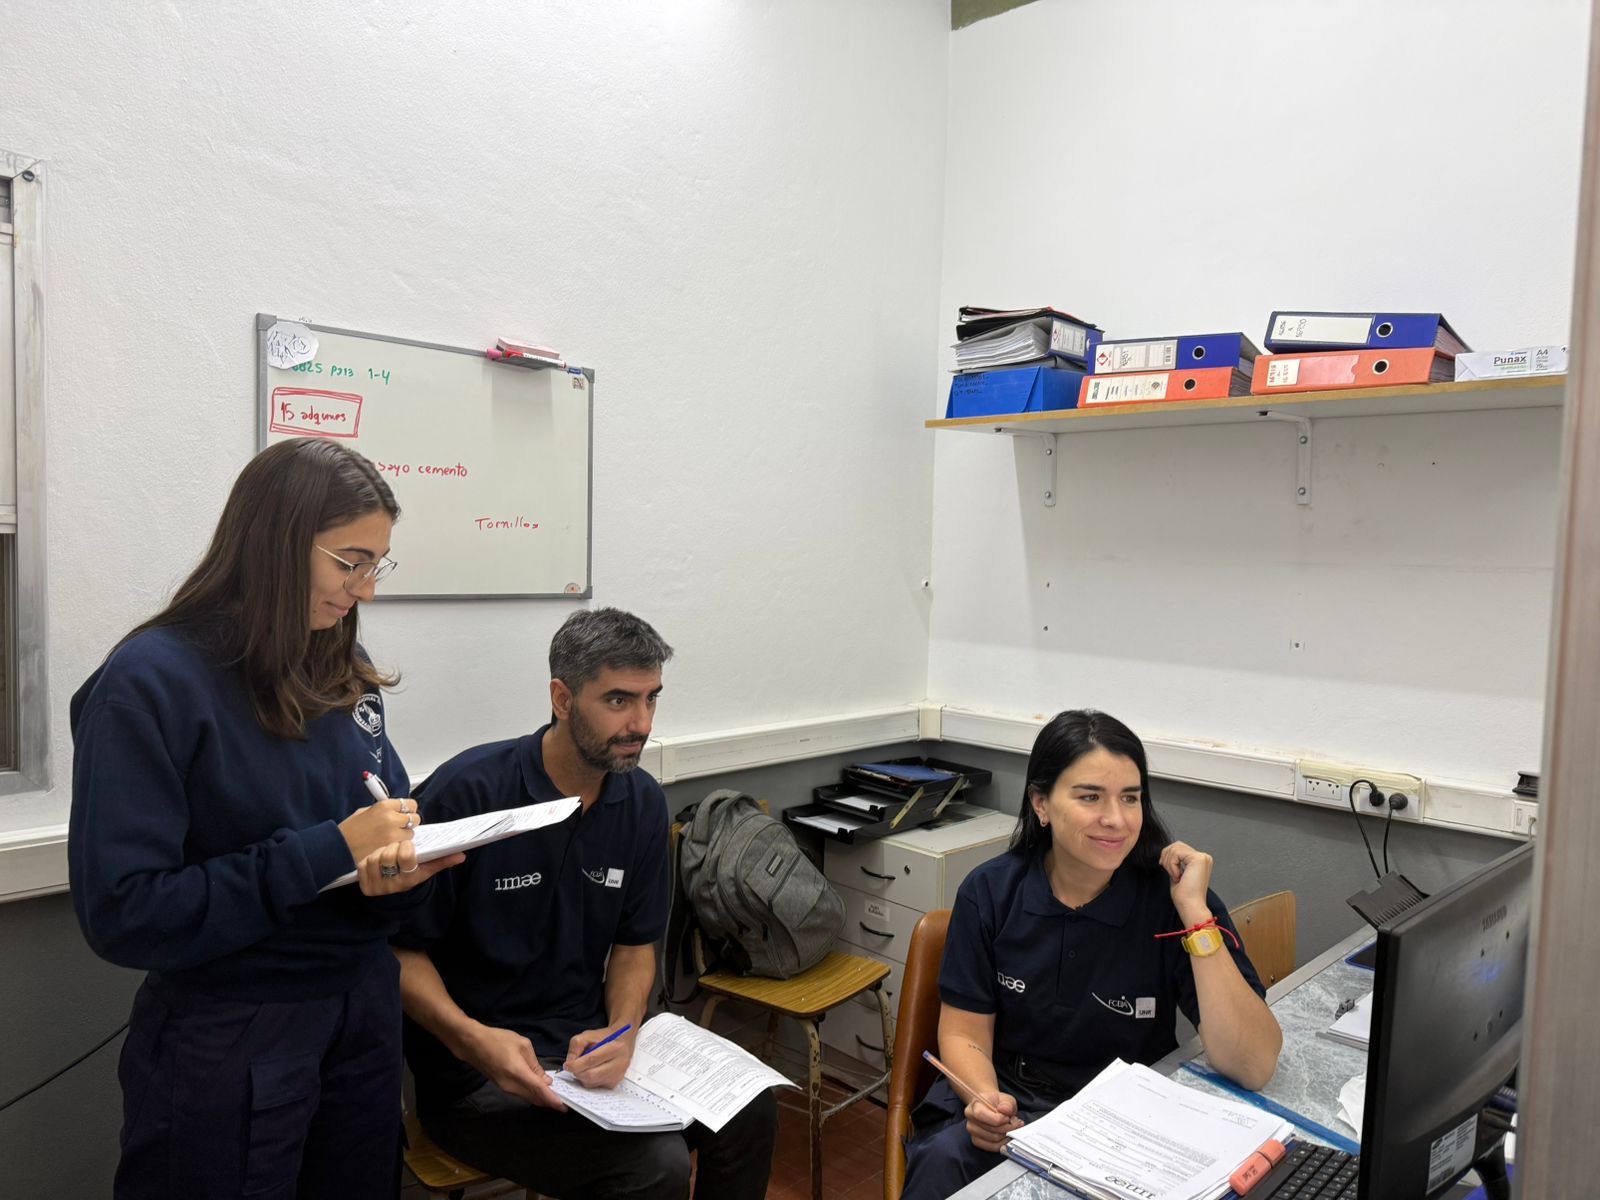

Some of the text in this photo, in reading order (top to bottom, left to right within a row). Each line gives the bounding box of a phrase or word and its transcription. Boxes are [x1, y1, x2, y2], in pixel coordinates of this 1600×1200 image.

[1536, 348, 1549, 356] A4
[1493, 356, 1527, 365] Punax
[368, 368, 391, 385] 1-4
[280, 401, 295, 421] 15
[374, 462, 468, 477] sayo cemento
[474, 517, 539, 531] Tornillos
